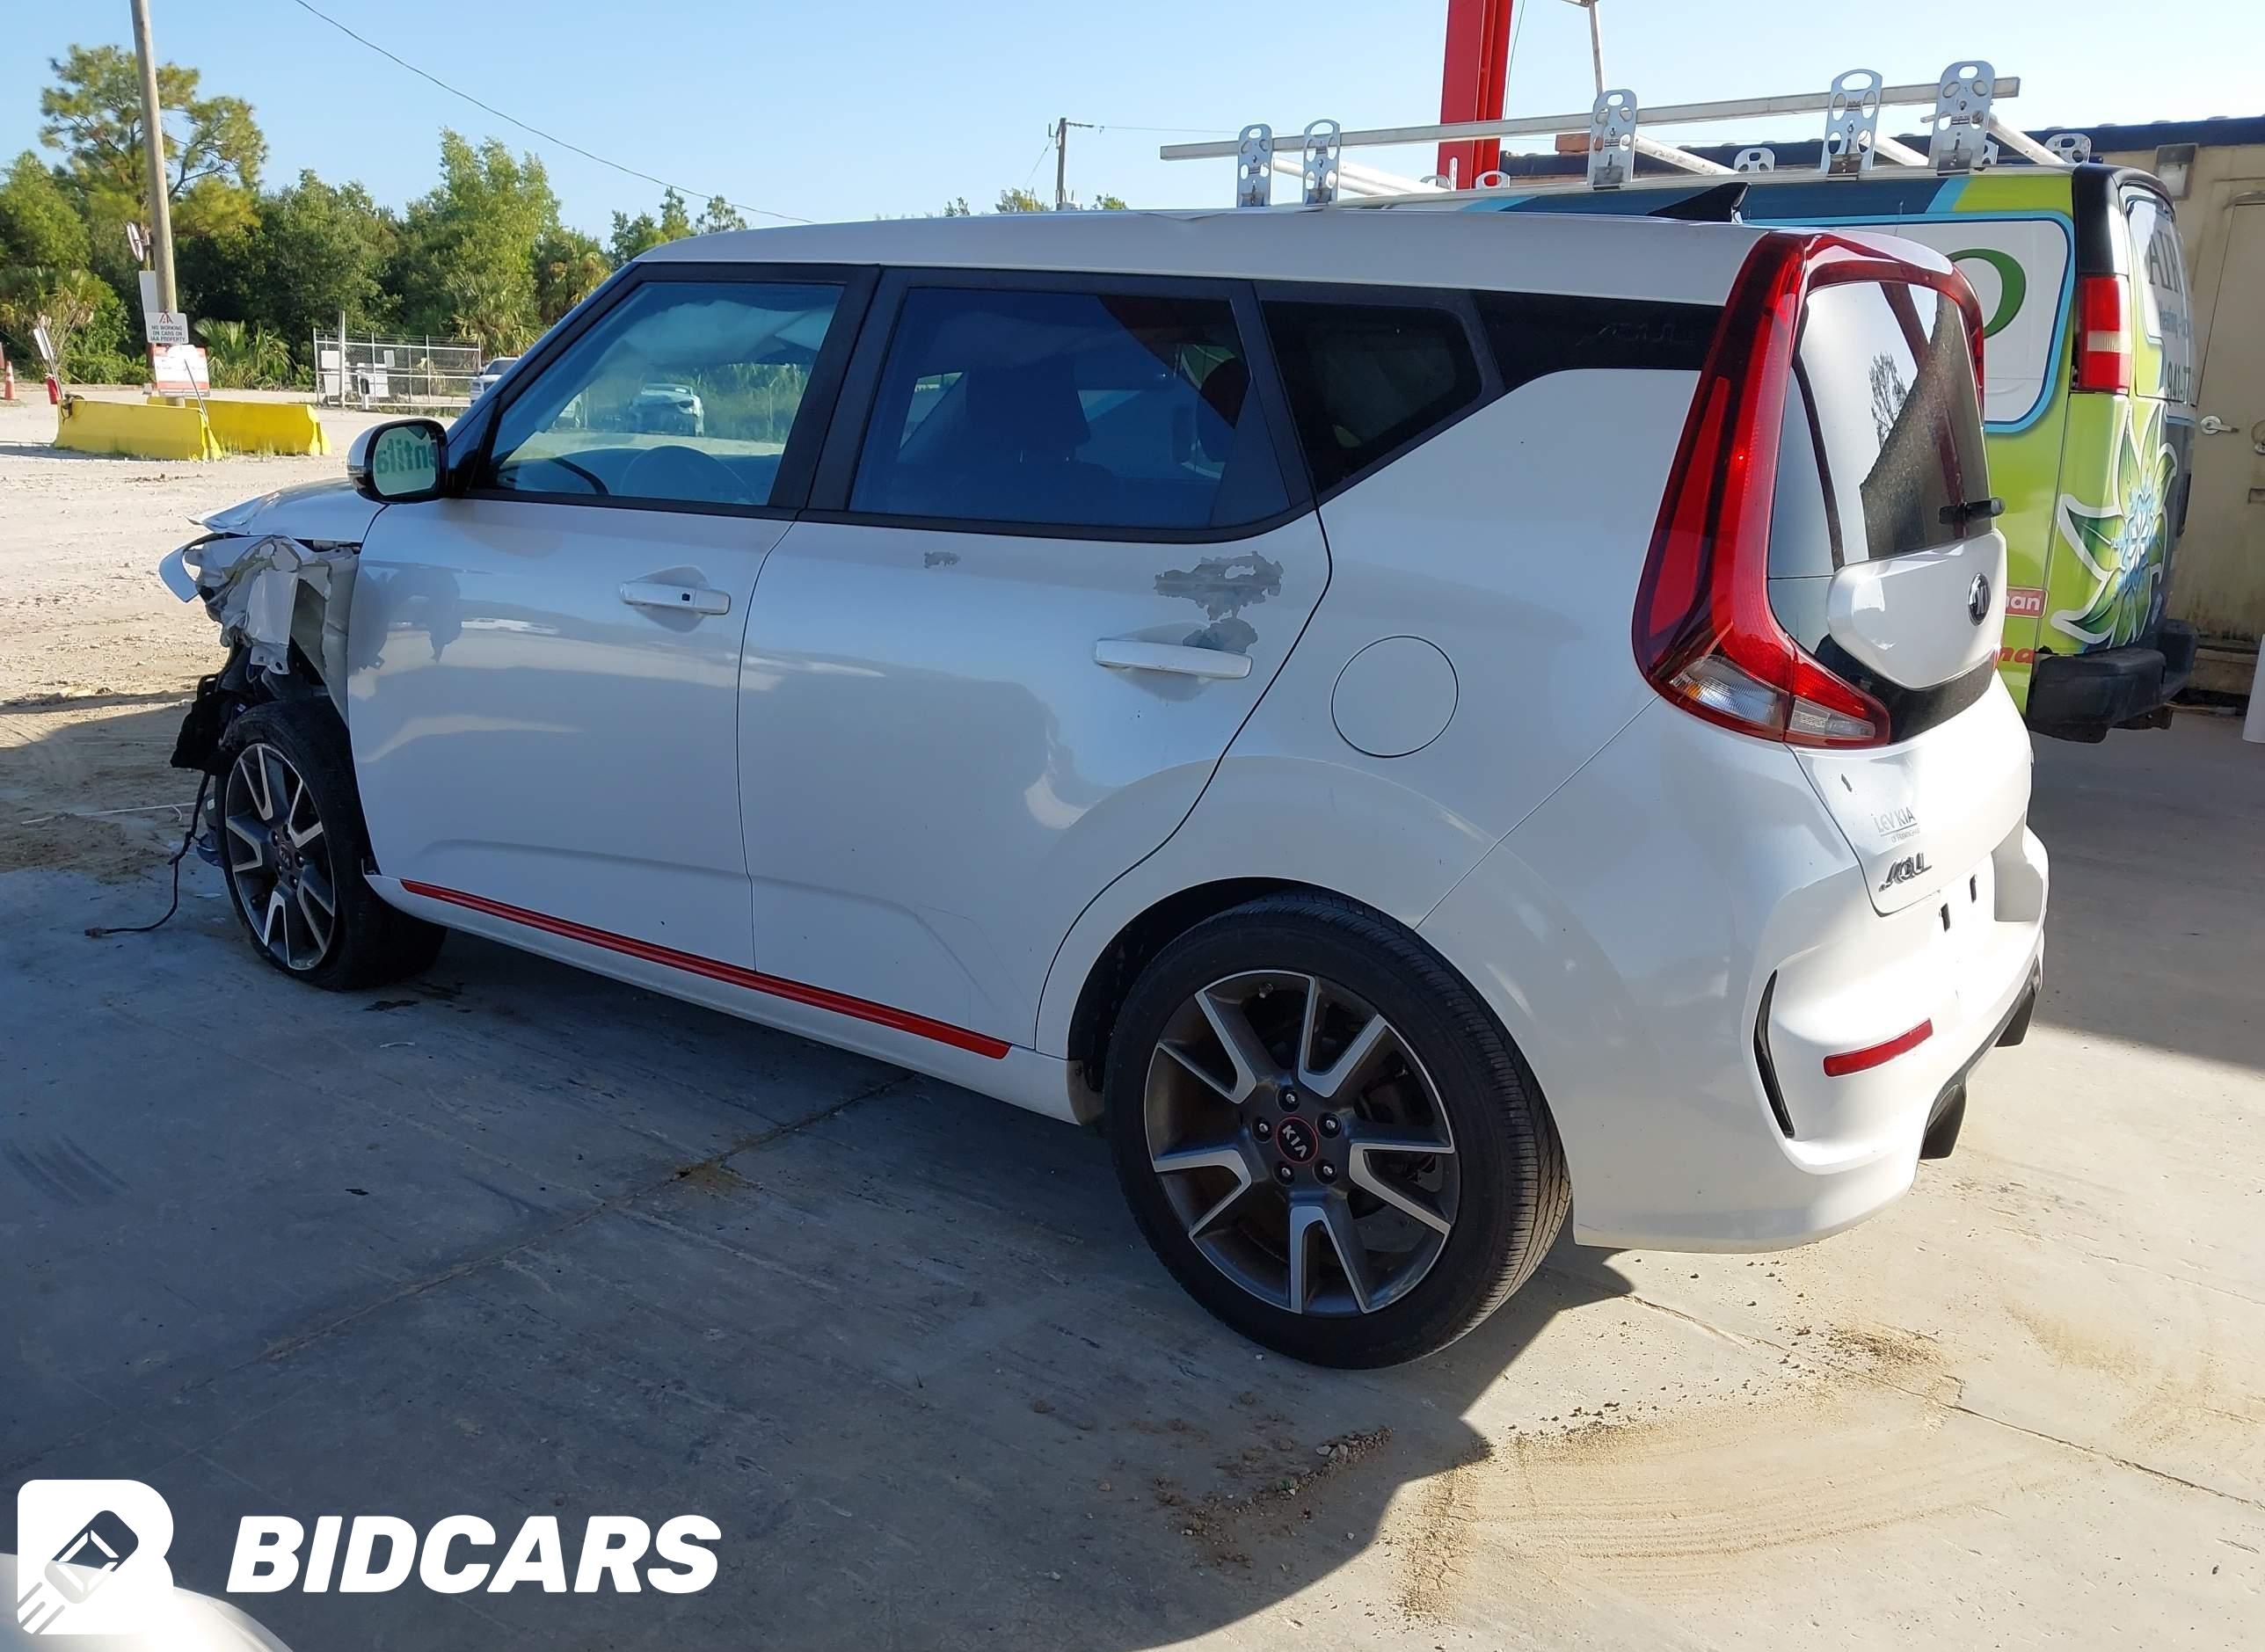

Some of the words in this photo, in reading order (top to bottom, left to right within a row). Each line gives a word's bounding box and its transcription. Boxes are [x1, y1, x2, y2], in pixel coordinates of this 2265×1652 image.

[2006, 595, 2041, 611] an
[1894, 806, 1917, 827] KIA
[1282, 1124, 1307, 1159] KIA
